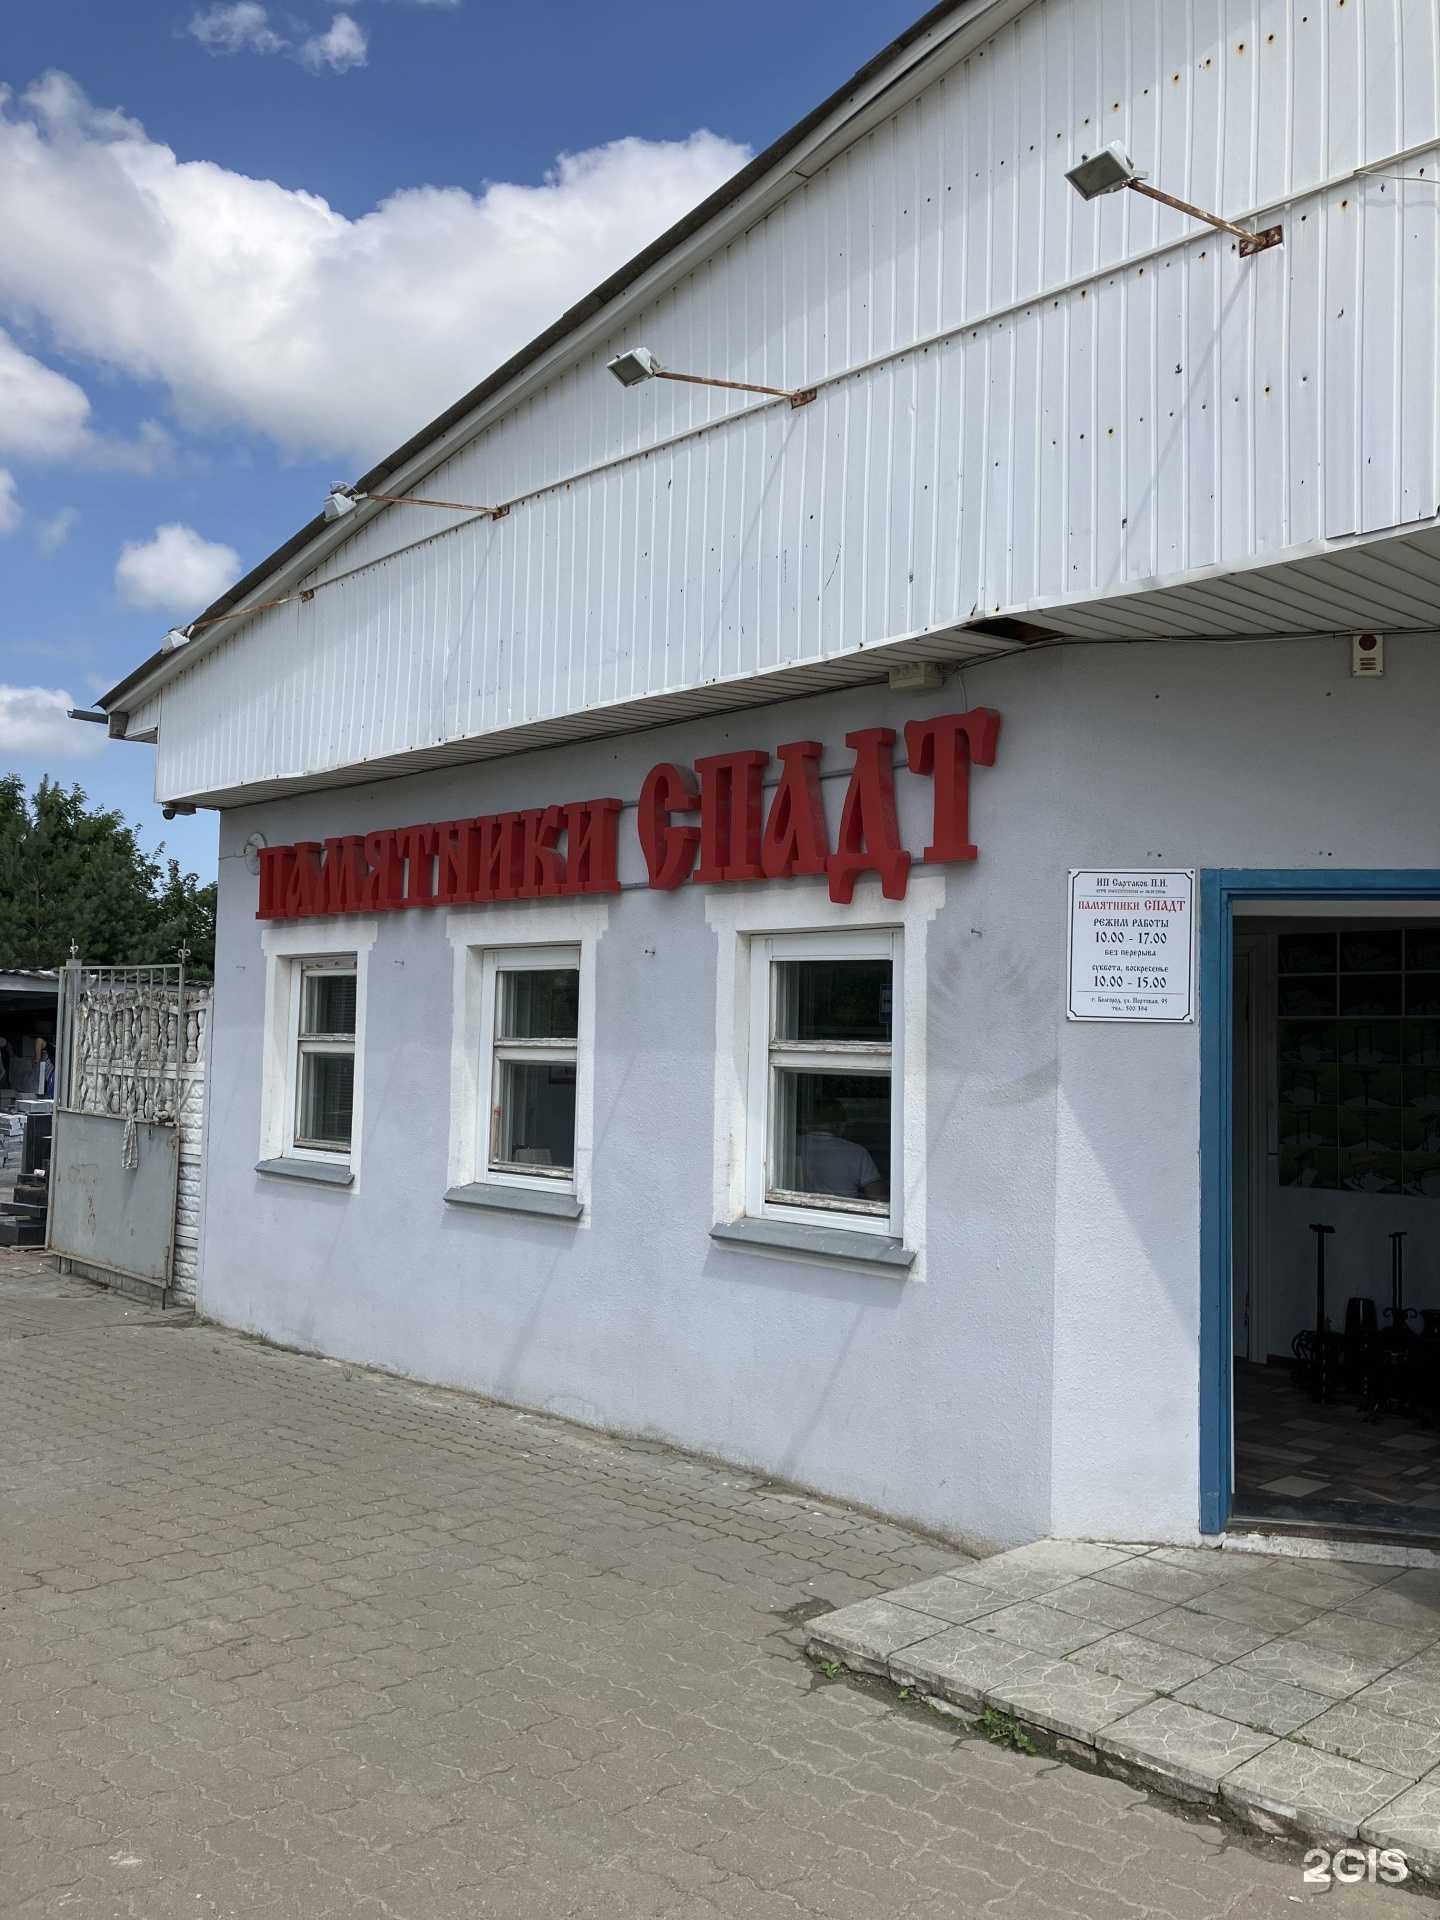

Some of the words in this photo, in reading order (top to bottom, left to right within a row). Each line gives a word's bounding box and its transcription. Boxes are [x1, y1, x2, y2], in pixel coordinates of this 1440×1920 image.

[256, 798, 623, 920] ПАМЯТНИКИ
[638, 706, 1001, 904] СПАДТ
[1078, 900, 1140, 911] ПАМЯТНИКИ
[1144, 899, 1186, 913] СПАДТ
[1093, 918, 1129, 928] РЕЖИМ
[1132, 919, 1169, 928] РАБОТЫ
[1095, 932, 1125, 944] 10.00
[1137, 932, 1167, 945] 17.00
[1094, 975, 1124, 987] 10.00
[1137, 976, 1167, 988] 15.00
